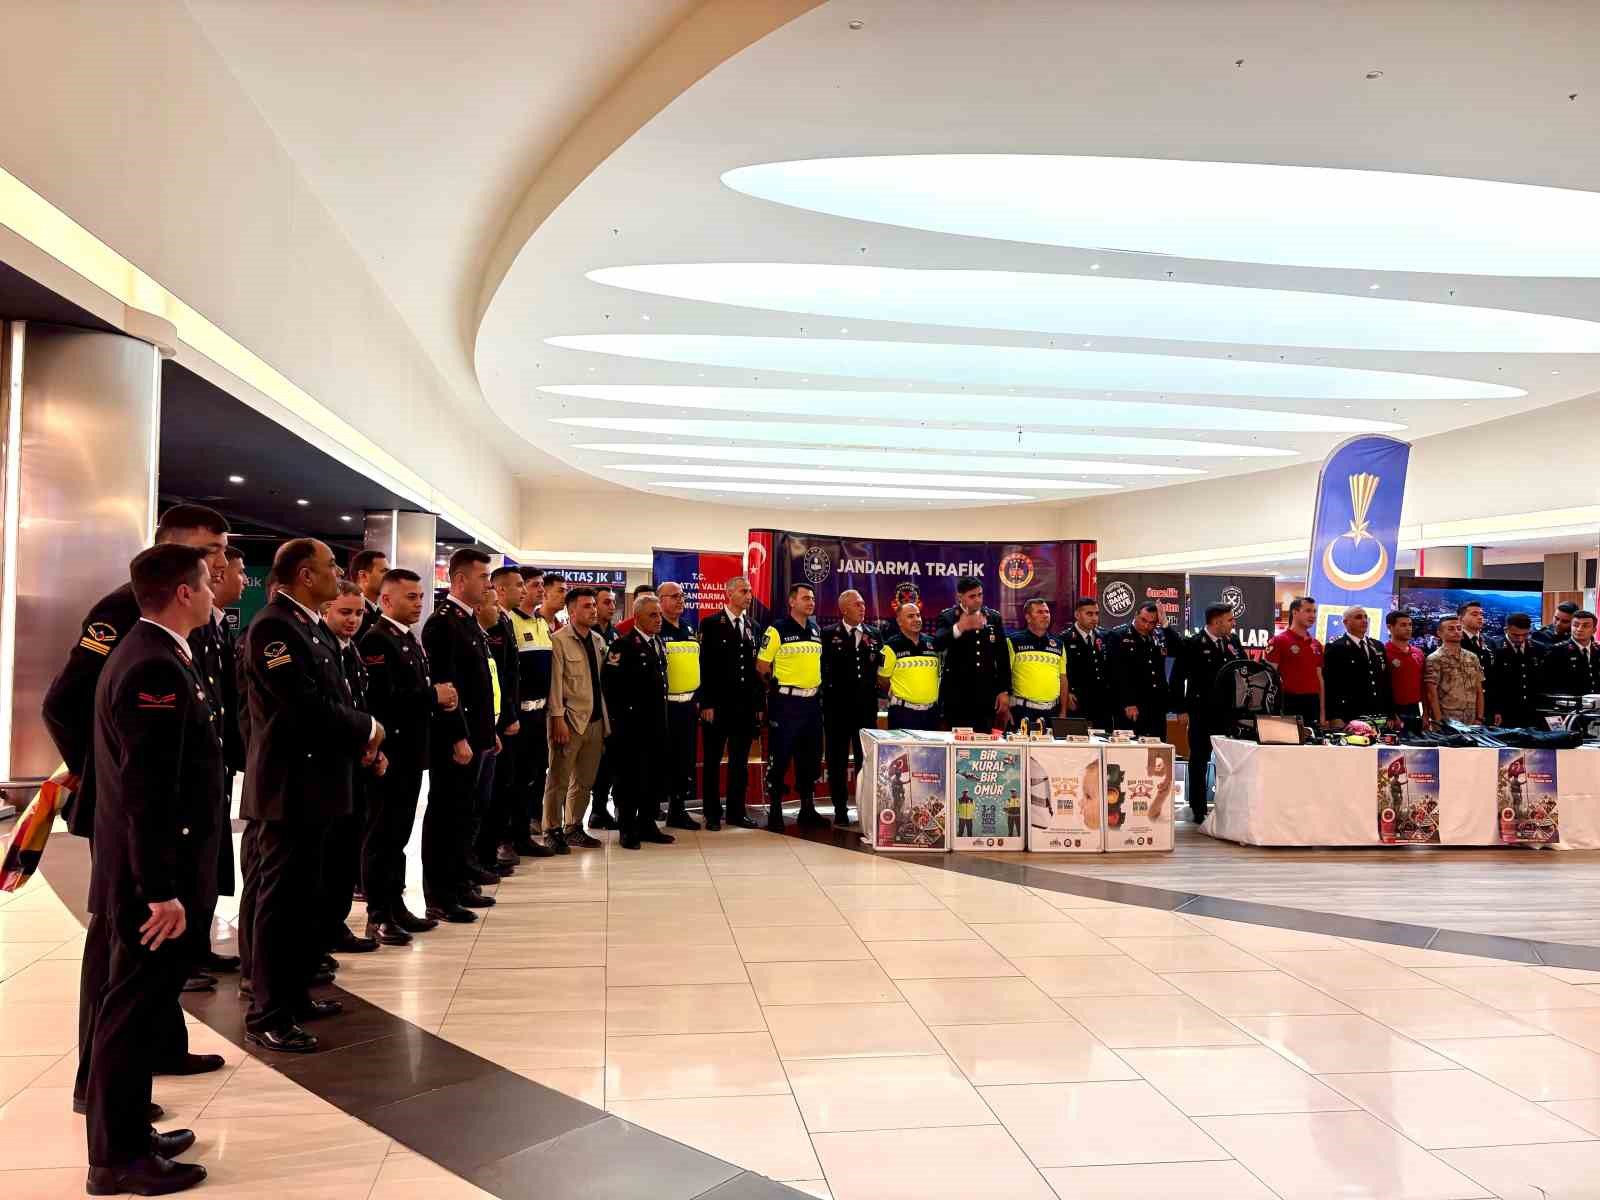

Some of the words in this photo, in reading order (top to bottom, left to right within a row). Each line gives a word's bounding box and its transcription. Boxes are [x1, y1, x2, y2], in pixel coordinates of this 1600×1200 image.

[837, 559, 921, 575] JANDARMA
[925, 560, 984, 577] TRAFİK
[596, 572, 608, 583] JK
[702, 582, 727, 590] VALİLİ
[980, 750, 997, 760] BİR
[972, 761, 1005, 771] KURAL
[980, 772, 997, 782] BİR
[974, 783, 1004, 796] ÖMÜR
